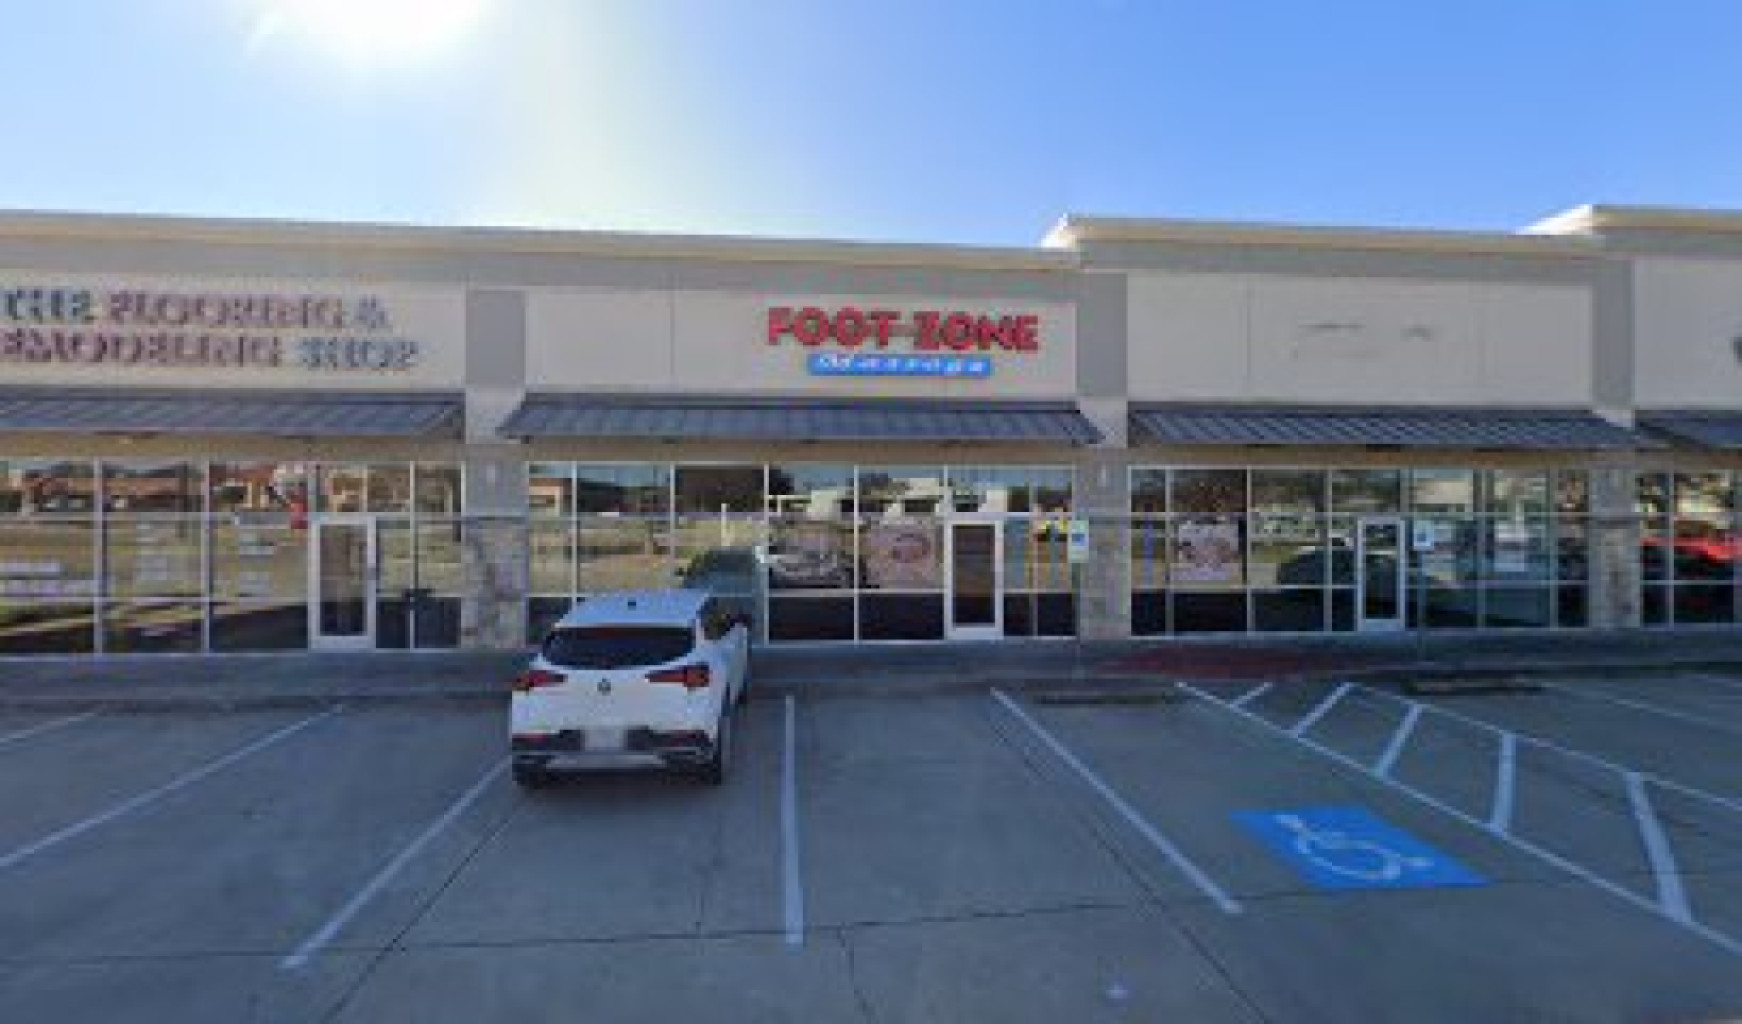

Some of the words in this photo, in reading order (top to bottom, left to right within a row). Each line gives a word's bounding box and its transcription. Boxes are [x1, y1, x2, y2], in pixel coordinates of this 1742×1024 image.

[4, 287, 93, 321] THE
[107, 290, 344, 329] FLOORING
[767, 306, 900, 348] FOOT
[913, 311, 1039, 351] ZONE
[298, 336, 419, 371] SHOP
